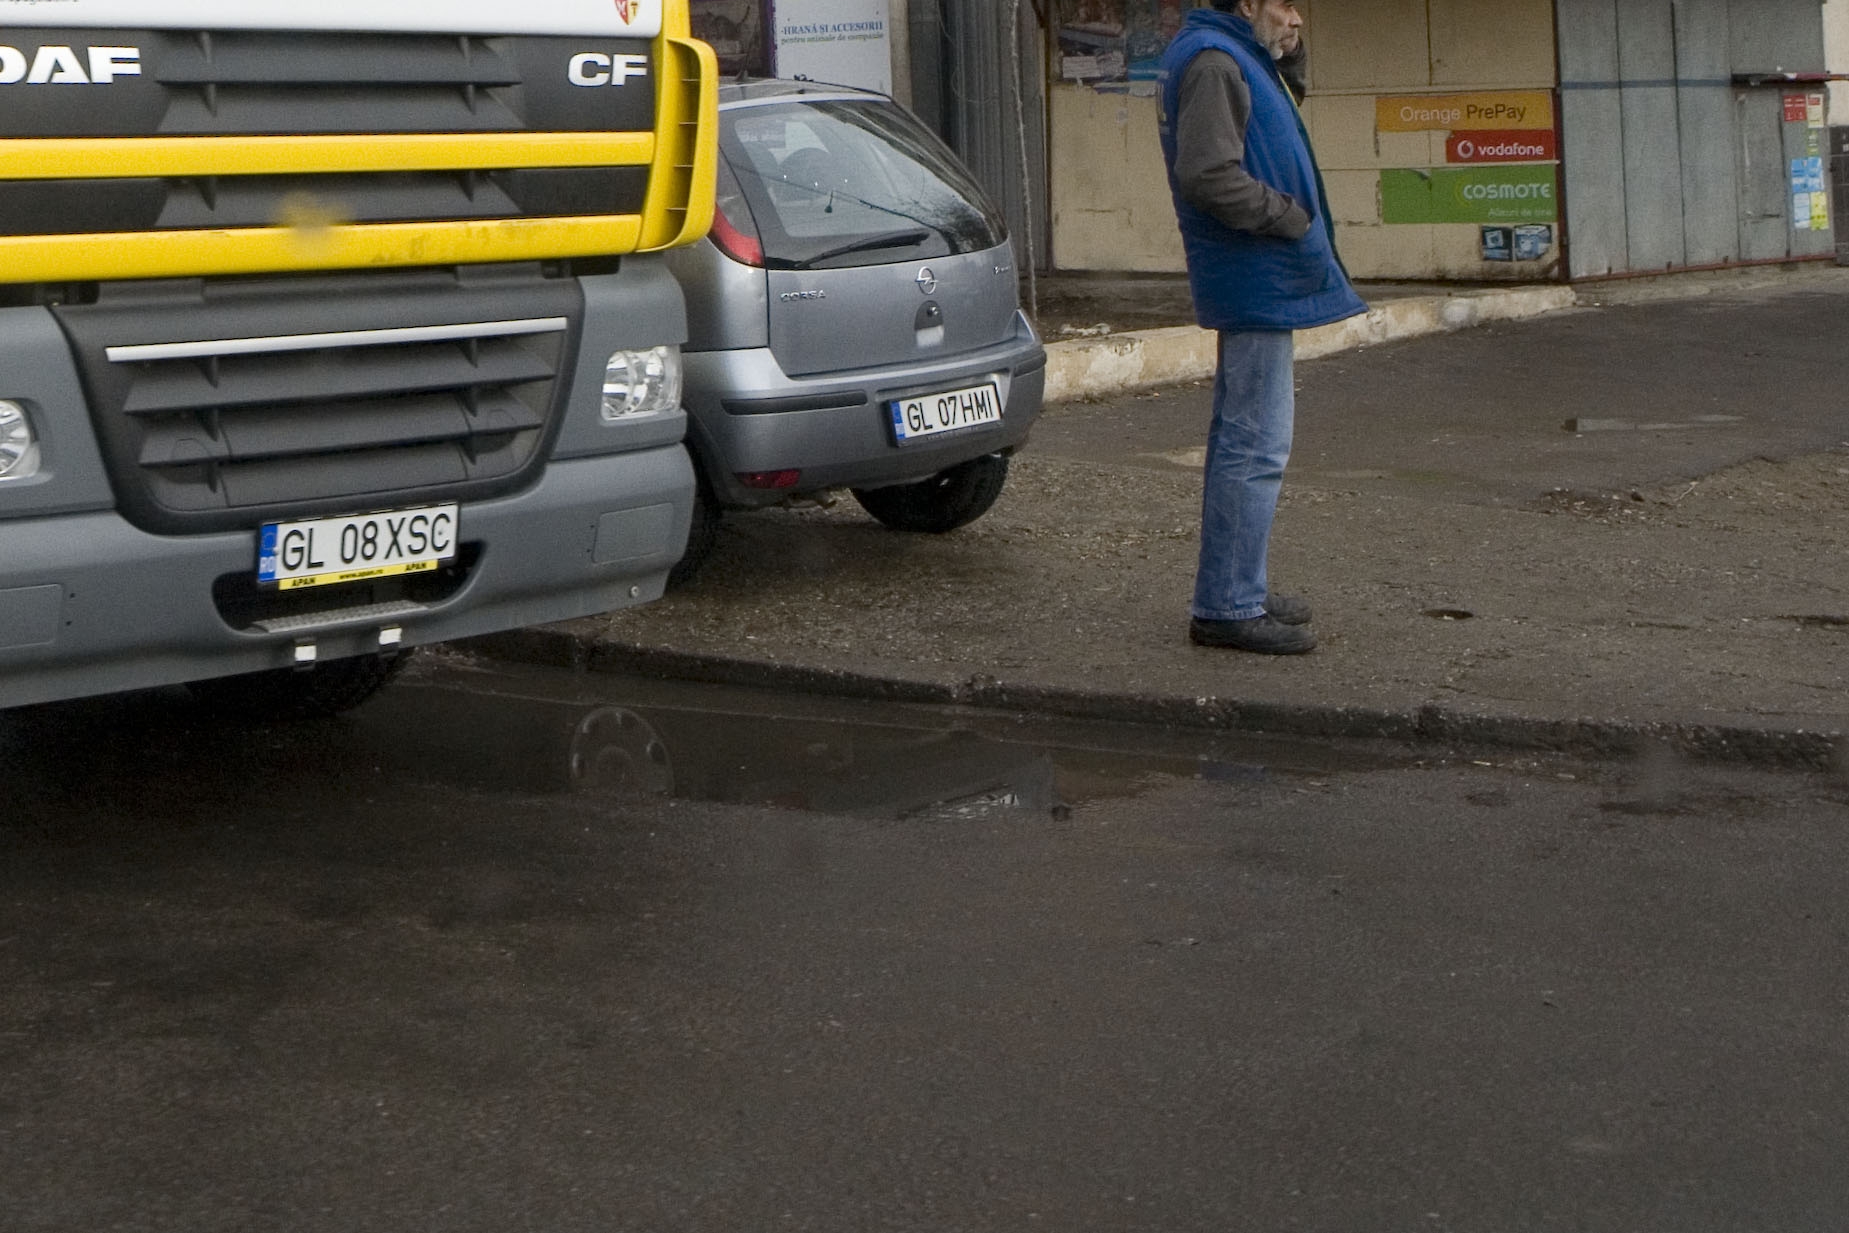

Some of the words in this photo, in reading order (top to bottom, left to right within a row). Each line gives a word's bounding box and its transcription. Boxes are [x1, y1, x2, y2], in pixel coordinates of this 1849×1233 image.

[568, 52, 648, 87] CF
[1400, 106, 1461, 124] Orange
[1466, 103, 1527, 122] PrePay
[1478, 142, 1544, 156] vodafone
[1463, 183, 1552, 199] COSMOTE
[907, 402, 933, 432] GL
[282, 528, 324, 571] GL
[291, 577, 316, 588] APAN
[404, 562, 427, 572] APAN
